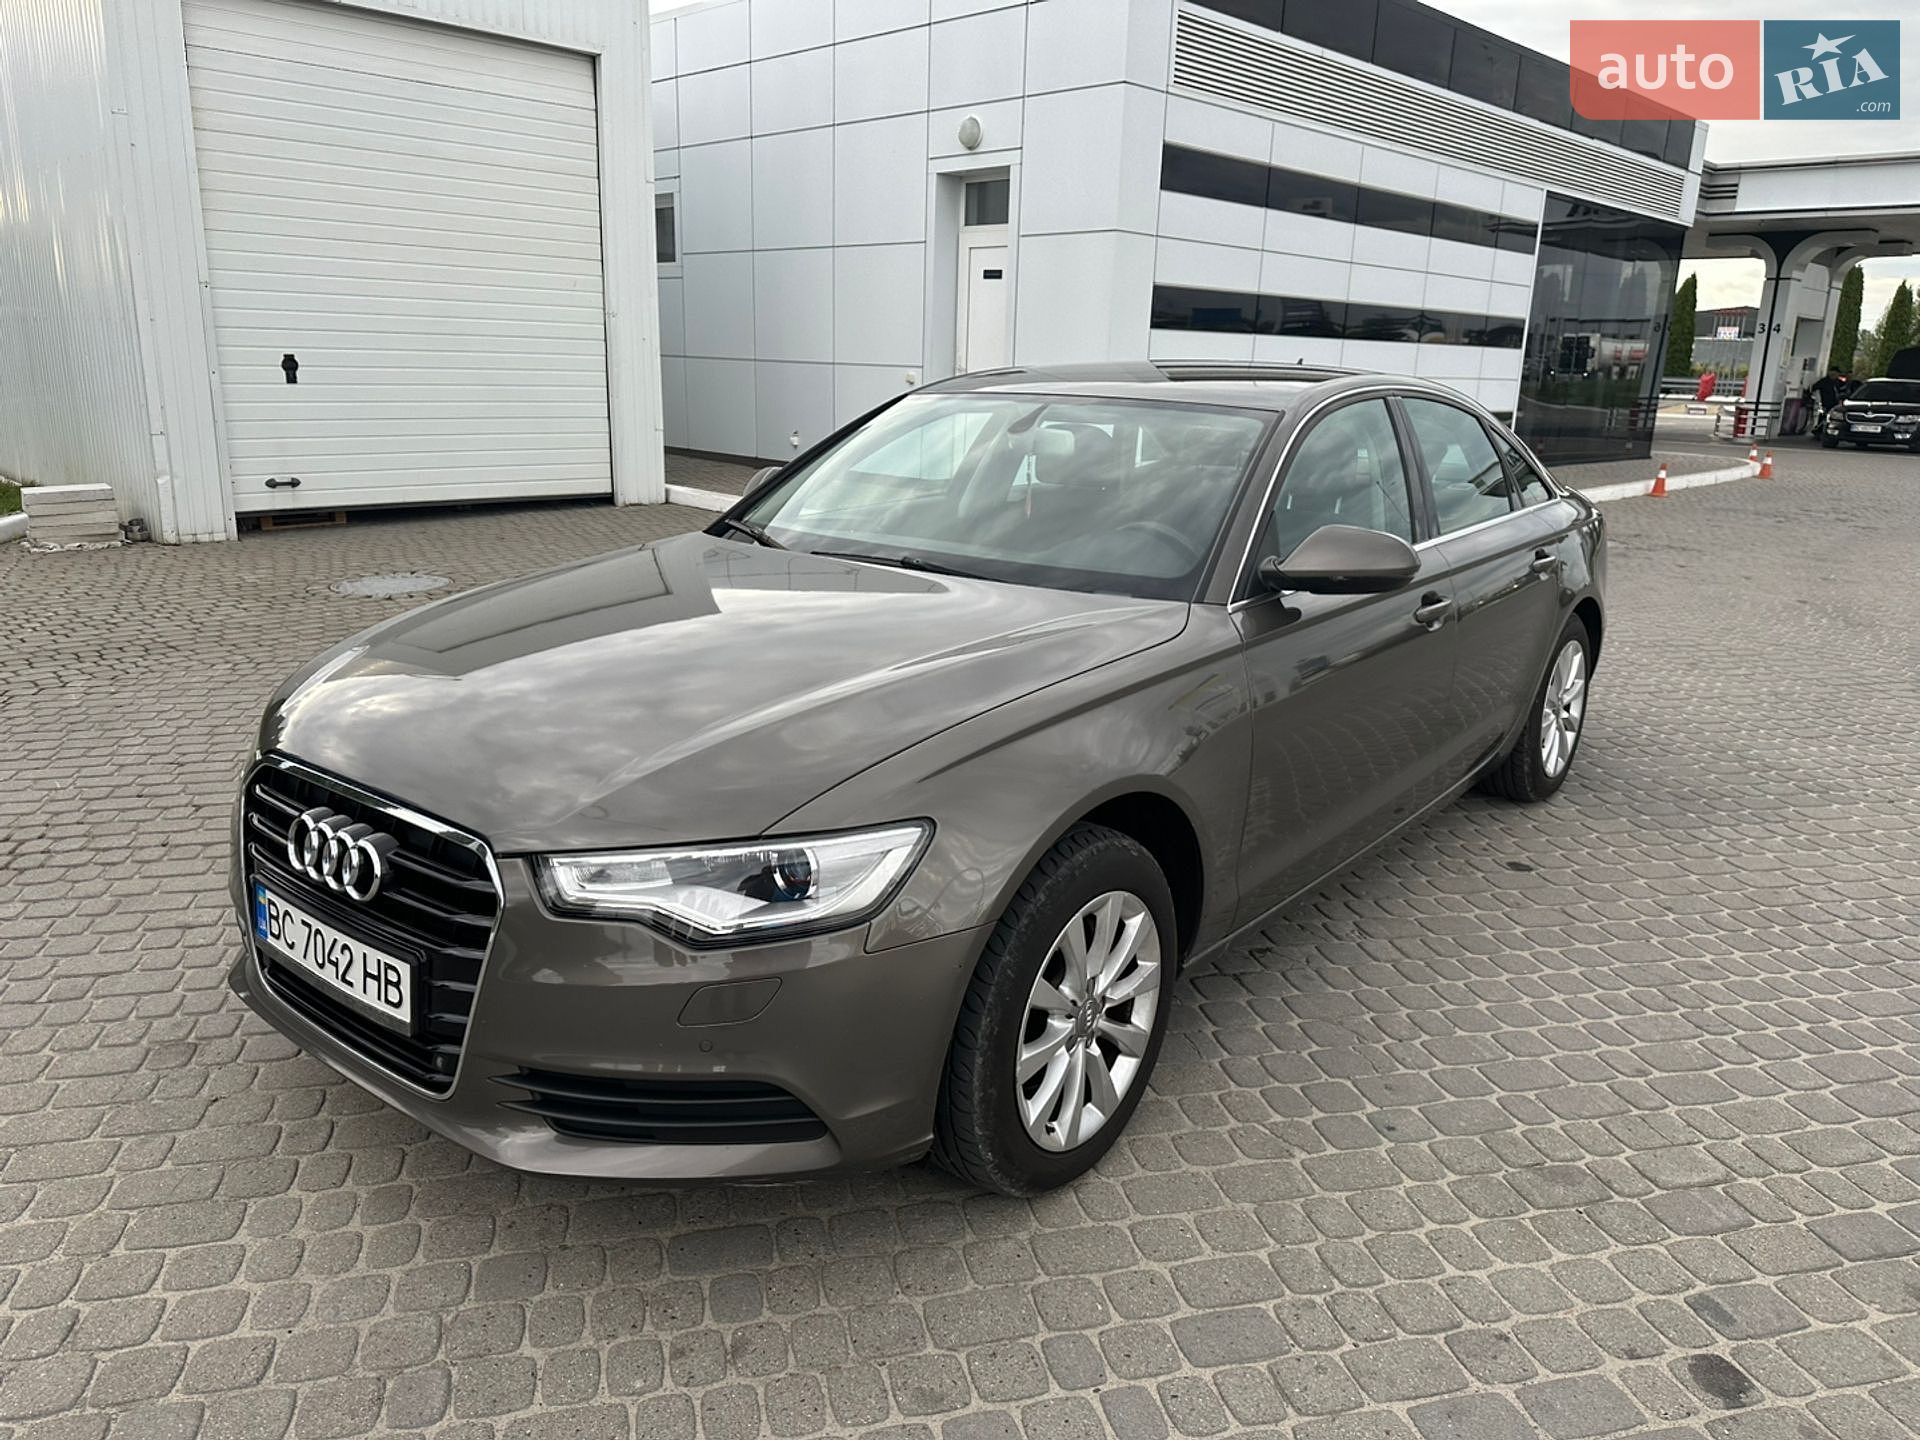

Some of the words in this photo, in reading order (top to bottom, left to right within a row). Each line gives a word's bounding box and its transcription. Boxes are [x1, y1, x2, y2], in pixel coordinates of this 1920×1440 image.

[1758, 323, 1766, 334] 3
[1773, 323, 1781, 334] 4
[267, 898, 295, 950] BC
[301, 920, 354, 988] 7042
[362, 952, 404, 1009] HB
